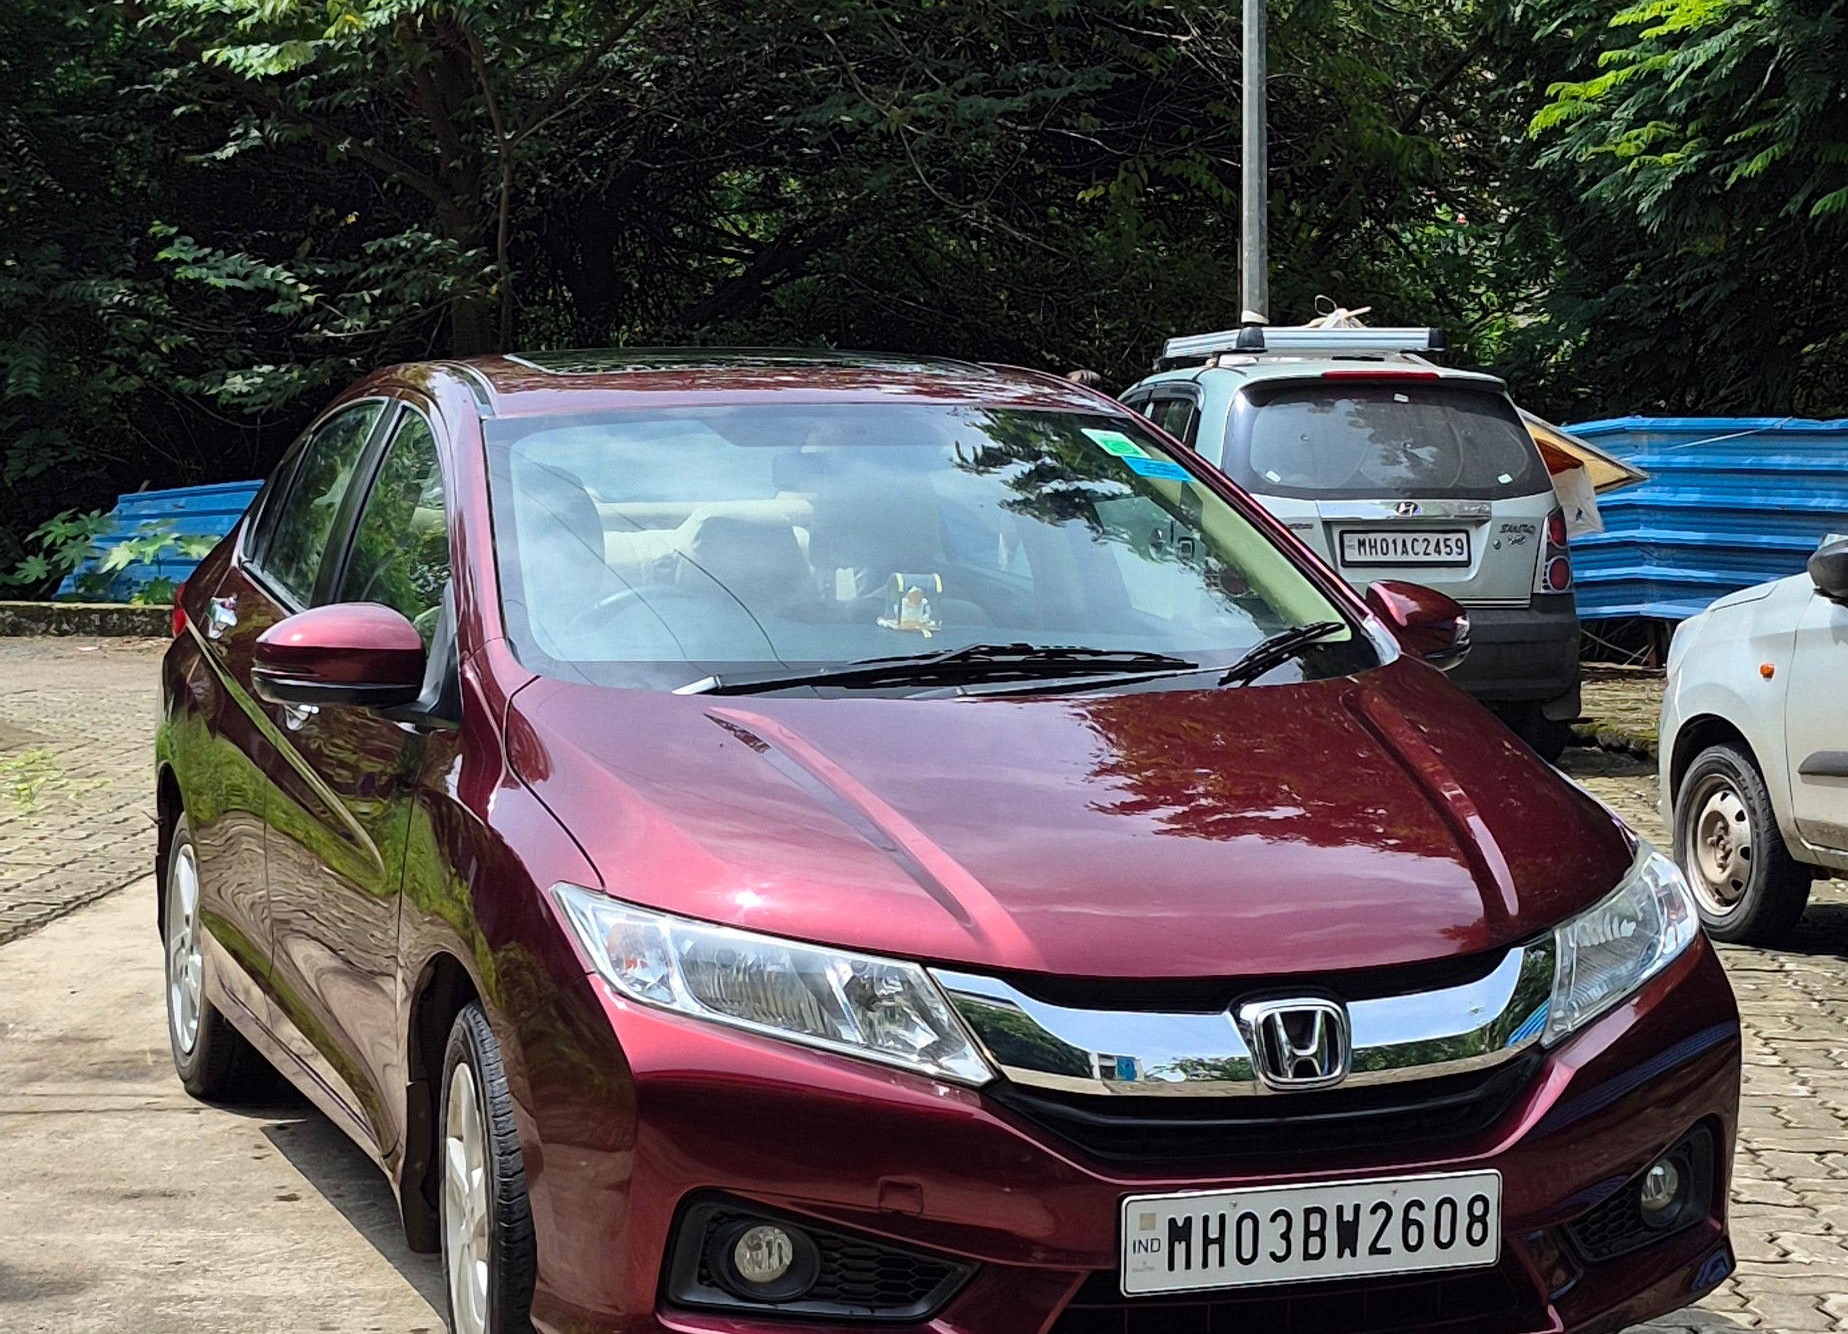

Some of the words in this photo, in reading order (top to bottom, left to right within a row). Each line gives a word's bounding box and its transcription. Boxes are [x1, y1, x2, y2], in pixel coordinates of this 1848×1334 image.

[1357, 537, 1465, 556] MH01AC2459
[1132, 1237, 1161, 1255] IND
[1166, 1193, 1491, 1272] MH03BW2608
